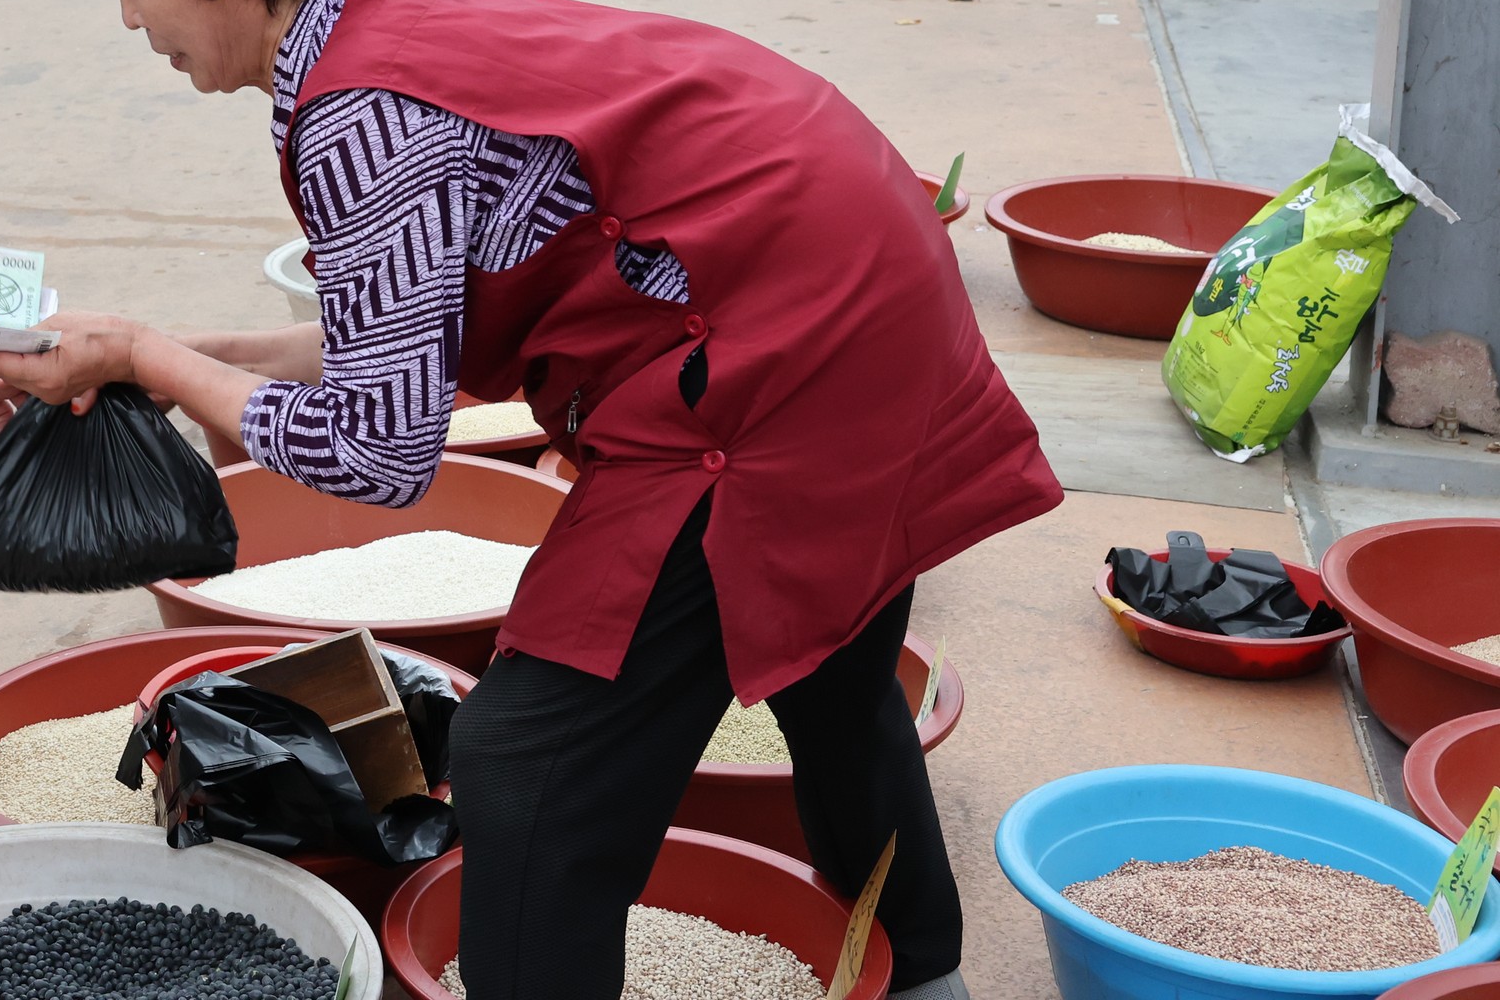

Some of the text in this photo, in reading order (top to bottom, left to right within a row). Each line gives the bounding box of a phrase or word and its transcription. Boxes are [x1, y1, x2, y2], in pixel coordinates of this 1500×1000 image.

[2, 257, 37, 271] 10000
[1265, 344, 1300, 394] 청자골
[1296, 286, 1341, 344] 메뚜기
[1333, 246, 1370, 276] 쌀
